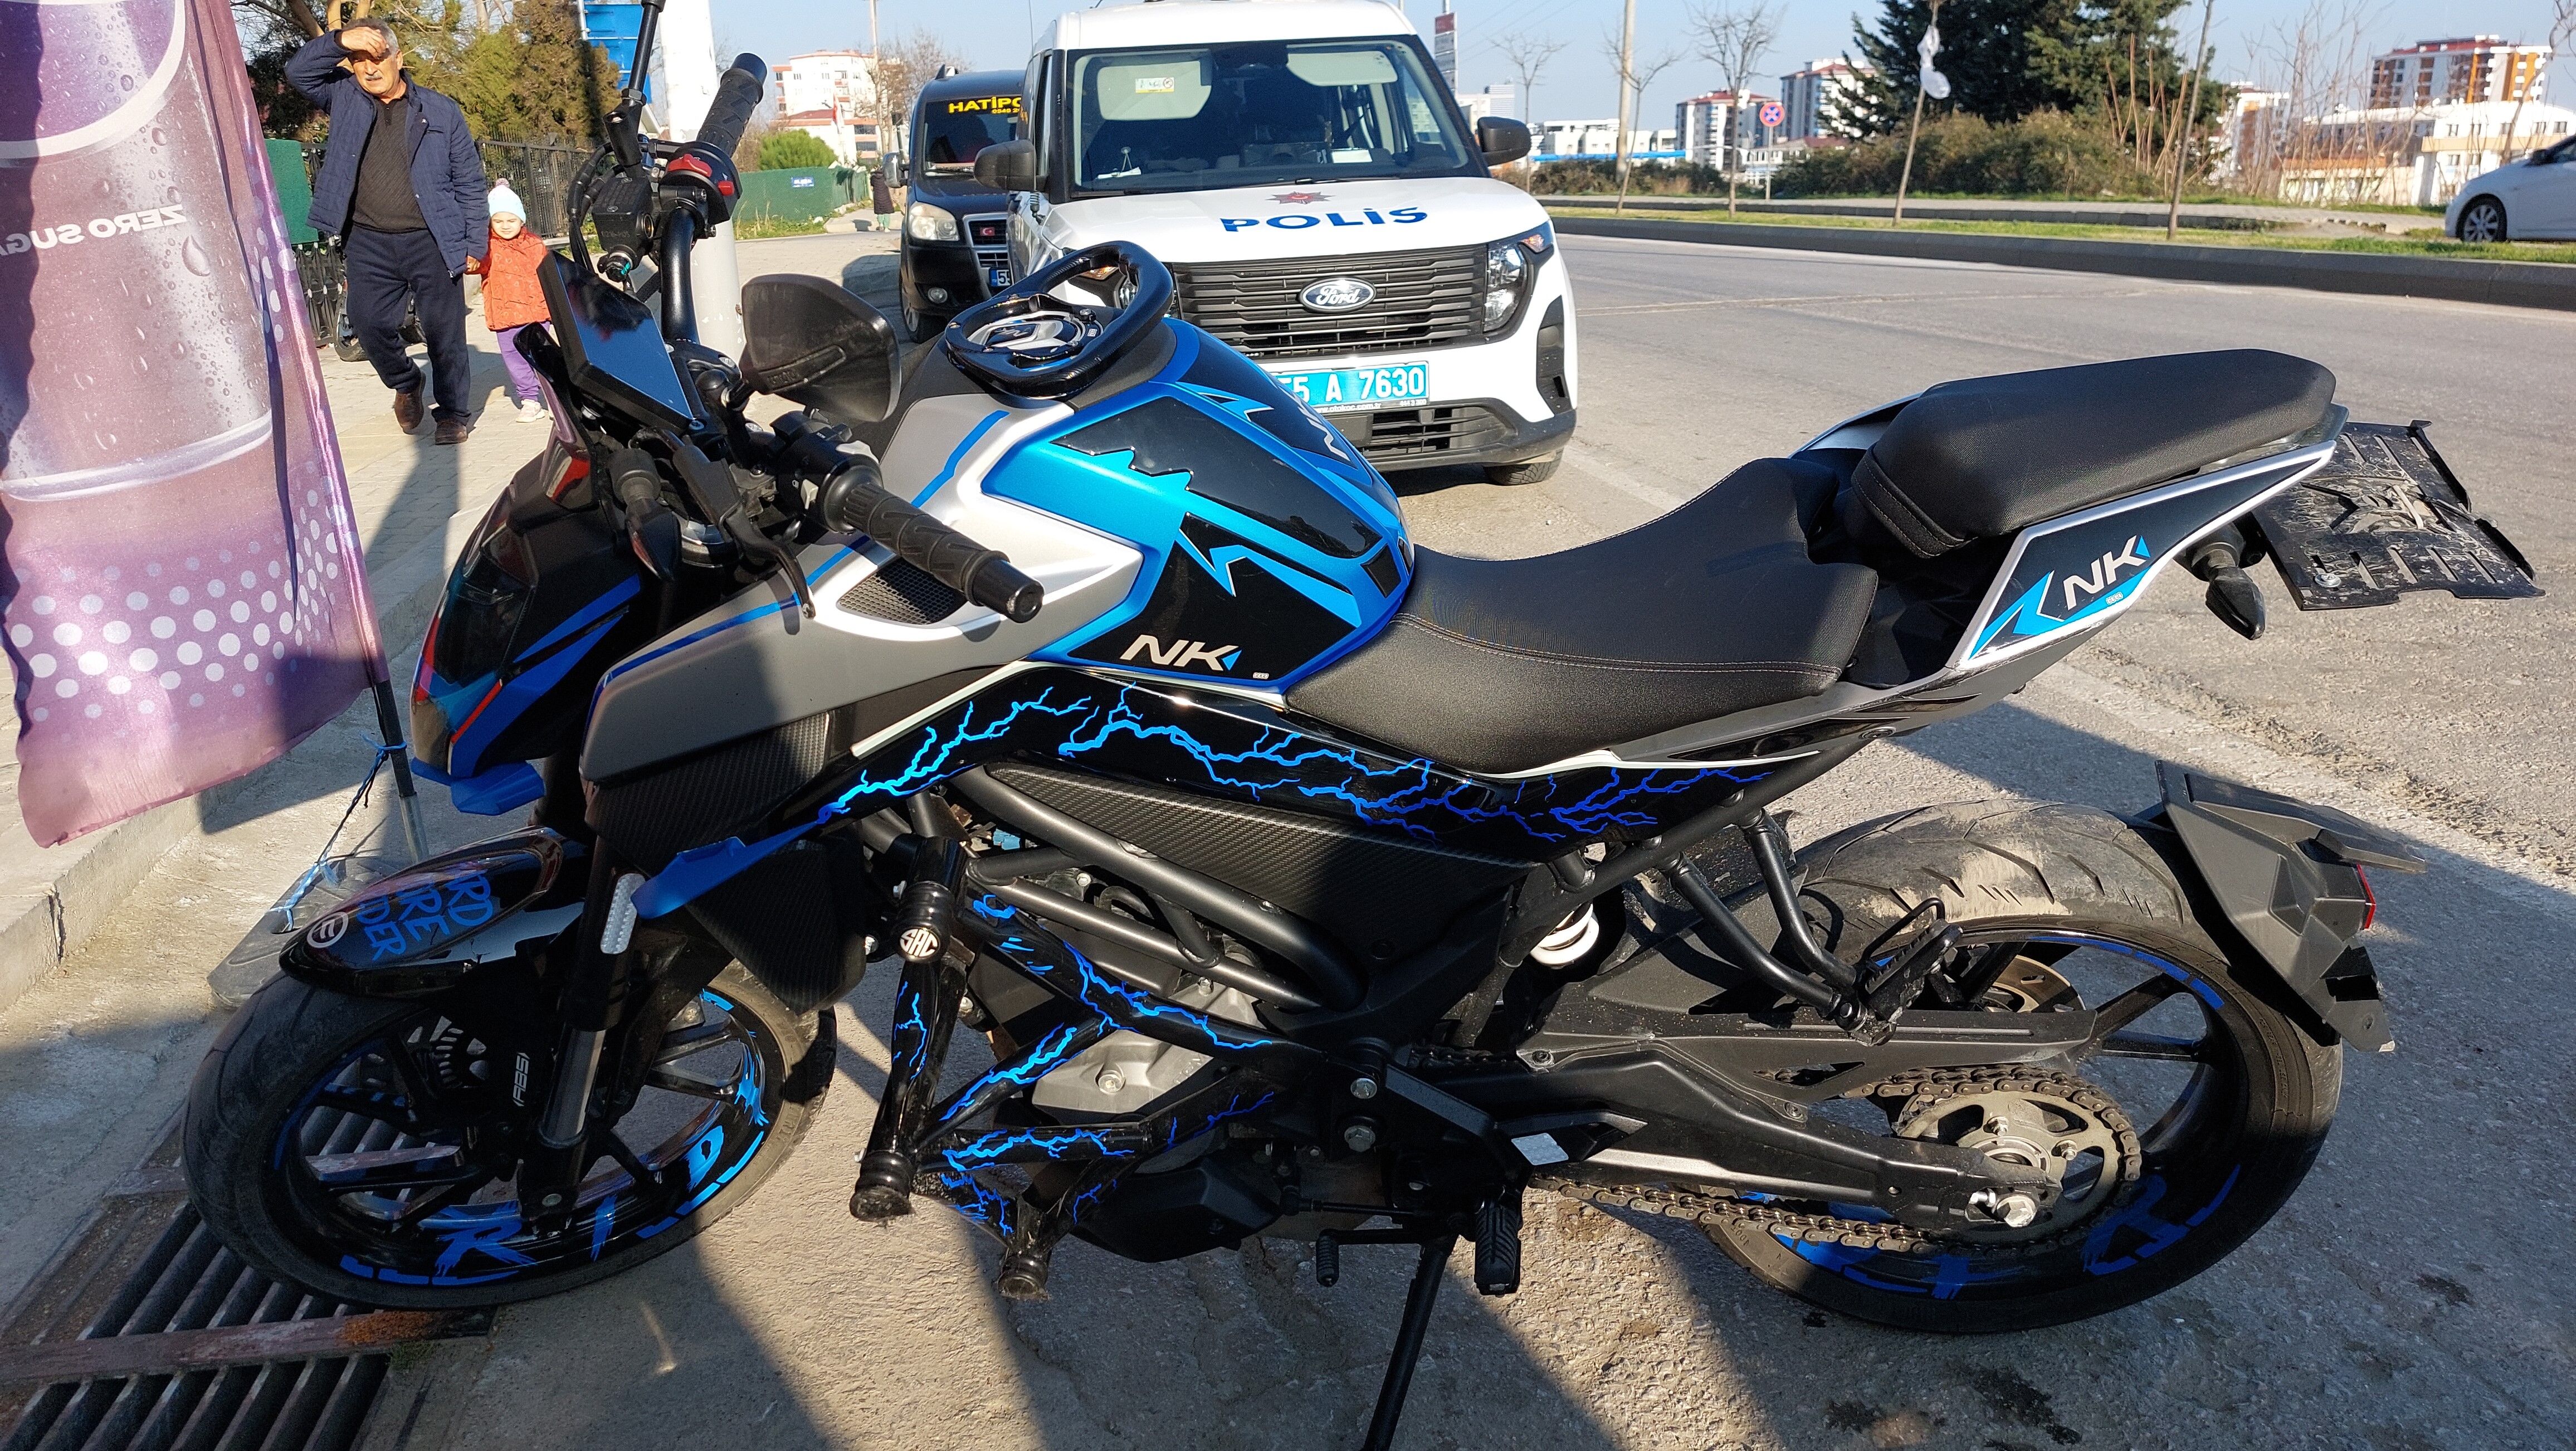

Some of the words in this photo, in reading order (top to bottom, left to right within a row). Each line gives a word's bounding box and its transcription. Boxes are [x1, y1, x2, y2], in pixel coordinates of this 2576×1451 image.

[1220, 207, 1427, 232] POLİS
[1316, 285, 1360, 305] Ford
[1325, 374, 1343, 402] A
[1359, 367, 1424, 400] 7630
[2063, 535, 2146, 611] NK
[1119, 634, 1239, 671] NK
